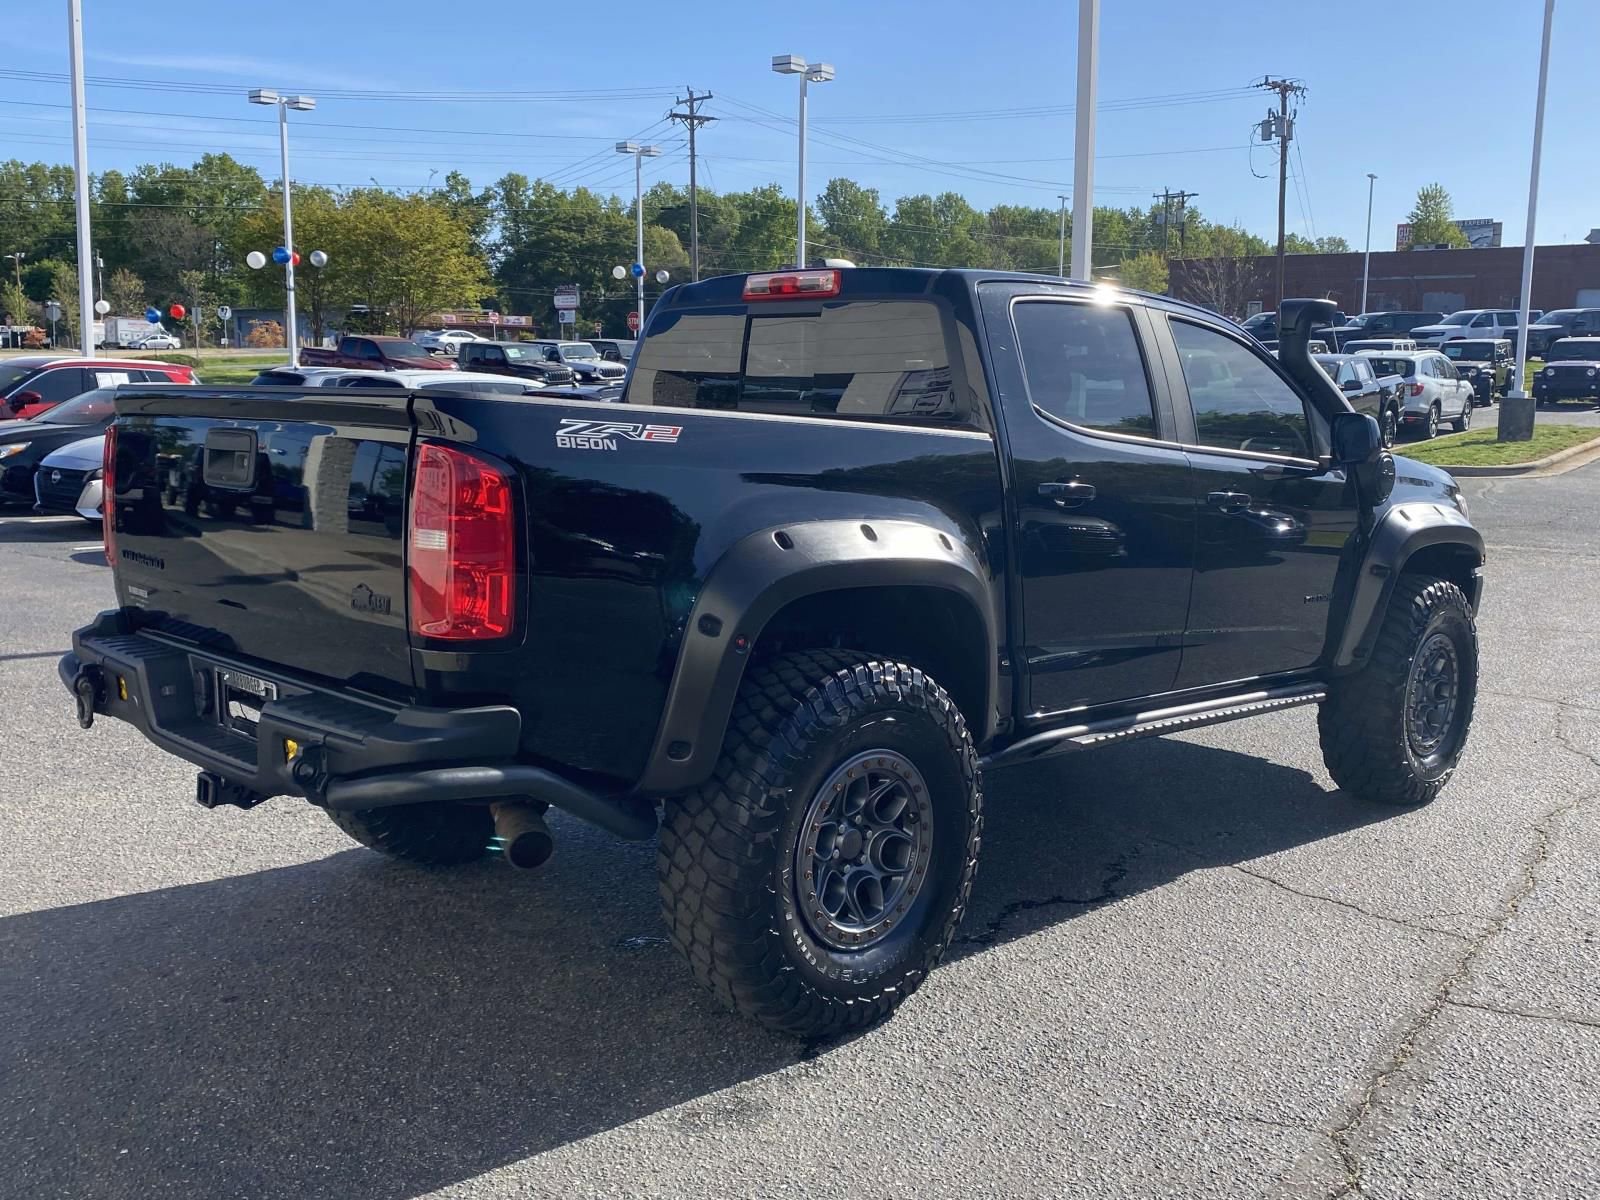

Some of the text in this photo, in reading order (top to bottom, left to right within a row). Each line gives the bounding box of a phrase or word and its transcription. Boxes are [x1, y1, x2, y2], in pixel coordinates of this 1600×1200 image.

[628, 317, 641, 325] STO
[555, 418, 683, 443] ZR2
[556, 436, 617, 451] BISON
